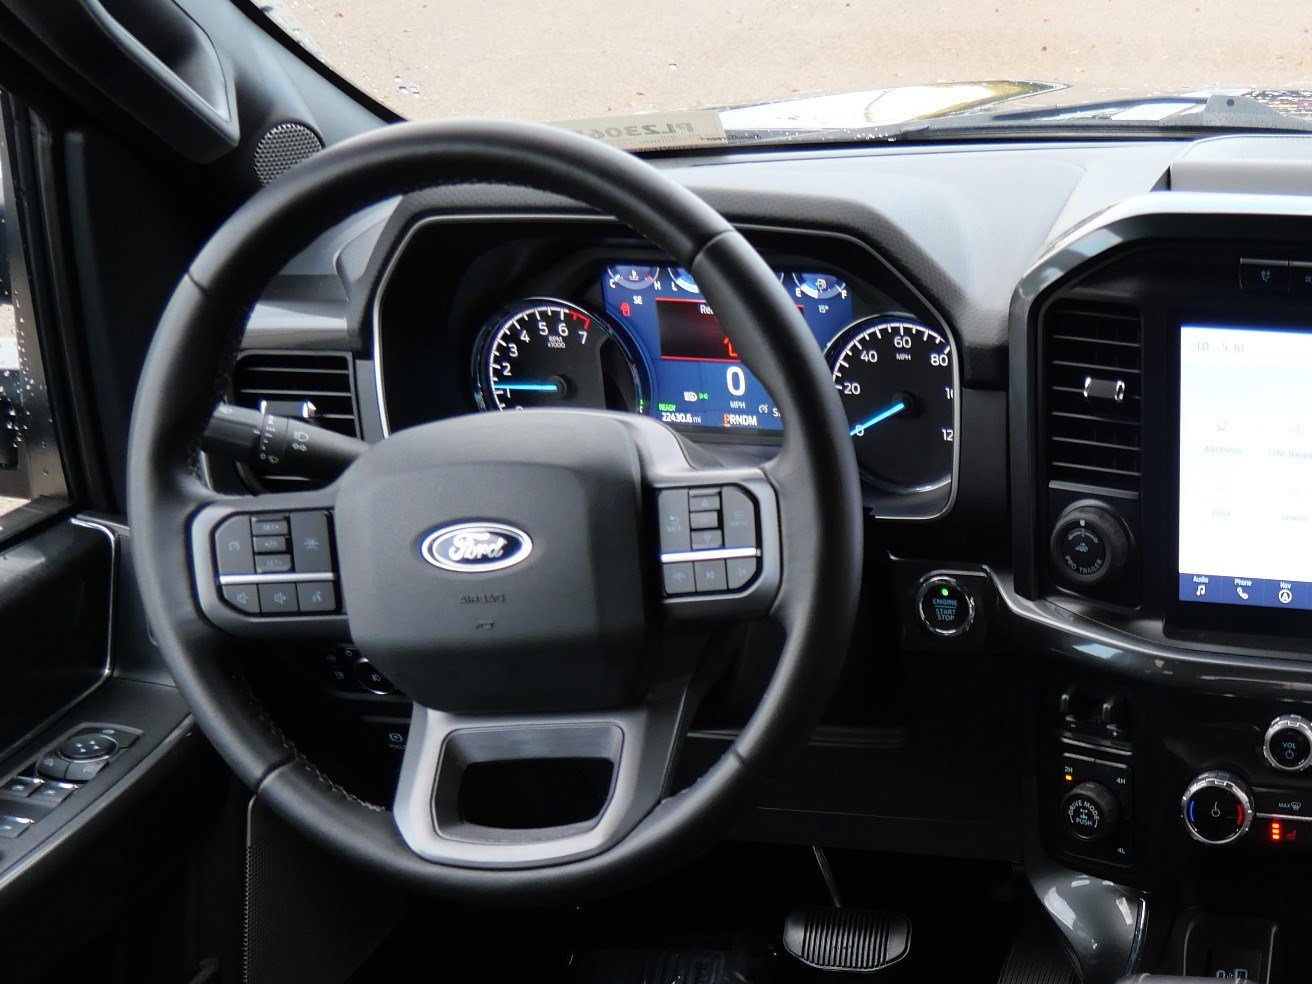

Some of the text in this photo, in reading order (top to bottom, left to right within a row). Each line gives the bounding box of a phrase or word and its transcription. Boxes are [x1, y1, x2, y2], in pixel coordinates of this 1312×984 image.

[654, 281, 661, 291] H
[633, 296, 643, 305] SE
[538, 322, 549, 335] 5
[558, 324, 569, 337] 6
[520, 330, 530, 343] 4
[578, 331, 588, 344] 7
[894, 337, 912, 348] 60
[509, 343, 519, 357] 3
[860, 350, 877, 363] 40
[931, 354, 948, 366] 80
[502, 363, 512, 376] 2
[726, 366, 746, 396] 0
[844, 383, 860, 395] 20
[730, 401, 746, 409] MPH
[942, 429, 954, 441] 12
[448, 532, 508, 561] Ford
[1065, 555, 1077, 570] PRO
[1193, 575, 1209, 584] Audio
[1234, 578, 1252, 587] Phone
[1280, 581, 1292, 589] Nav
[1283, 742, 1296, 750] VOL
[1116, 777, 1126, 785] 4H
[1068, 800, 1100, 820] DRIVE MODE
[1076, 818, 1093, 827] PUSH
